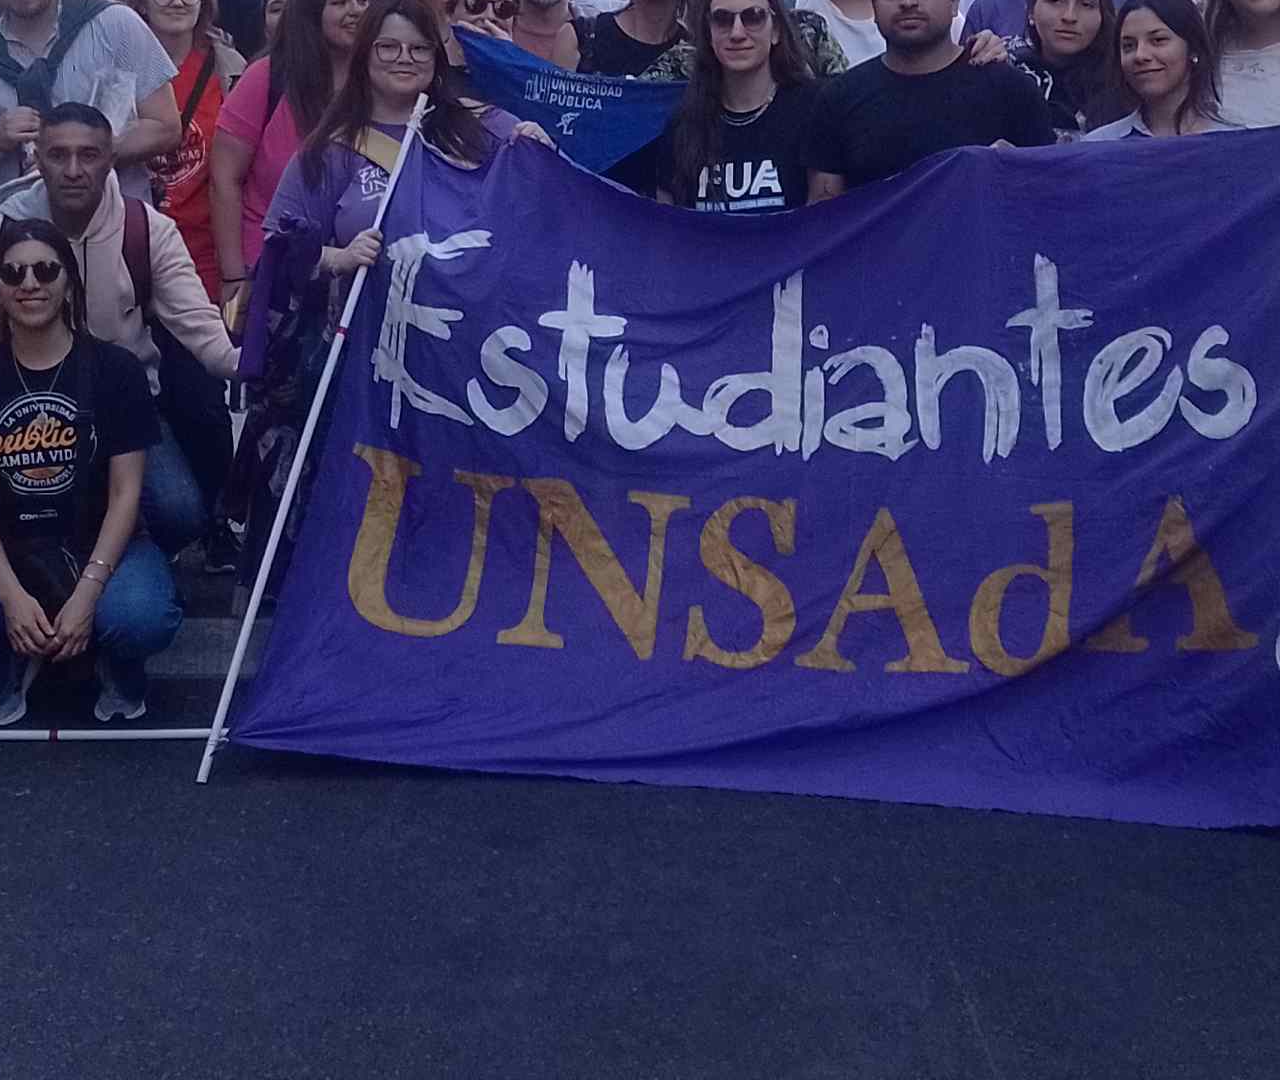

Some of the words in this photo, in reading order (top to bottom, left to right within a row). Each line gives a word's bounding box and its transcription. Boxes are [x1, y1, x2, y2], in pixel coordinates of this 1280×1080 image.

[551, 77, 623, 98] UNIVERSIDAD
[48, 448, 77, 463] VID
[346, 443, 1260, 678] UNSAdA
